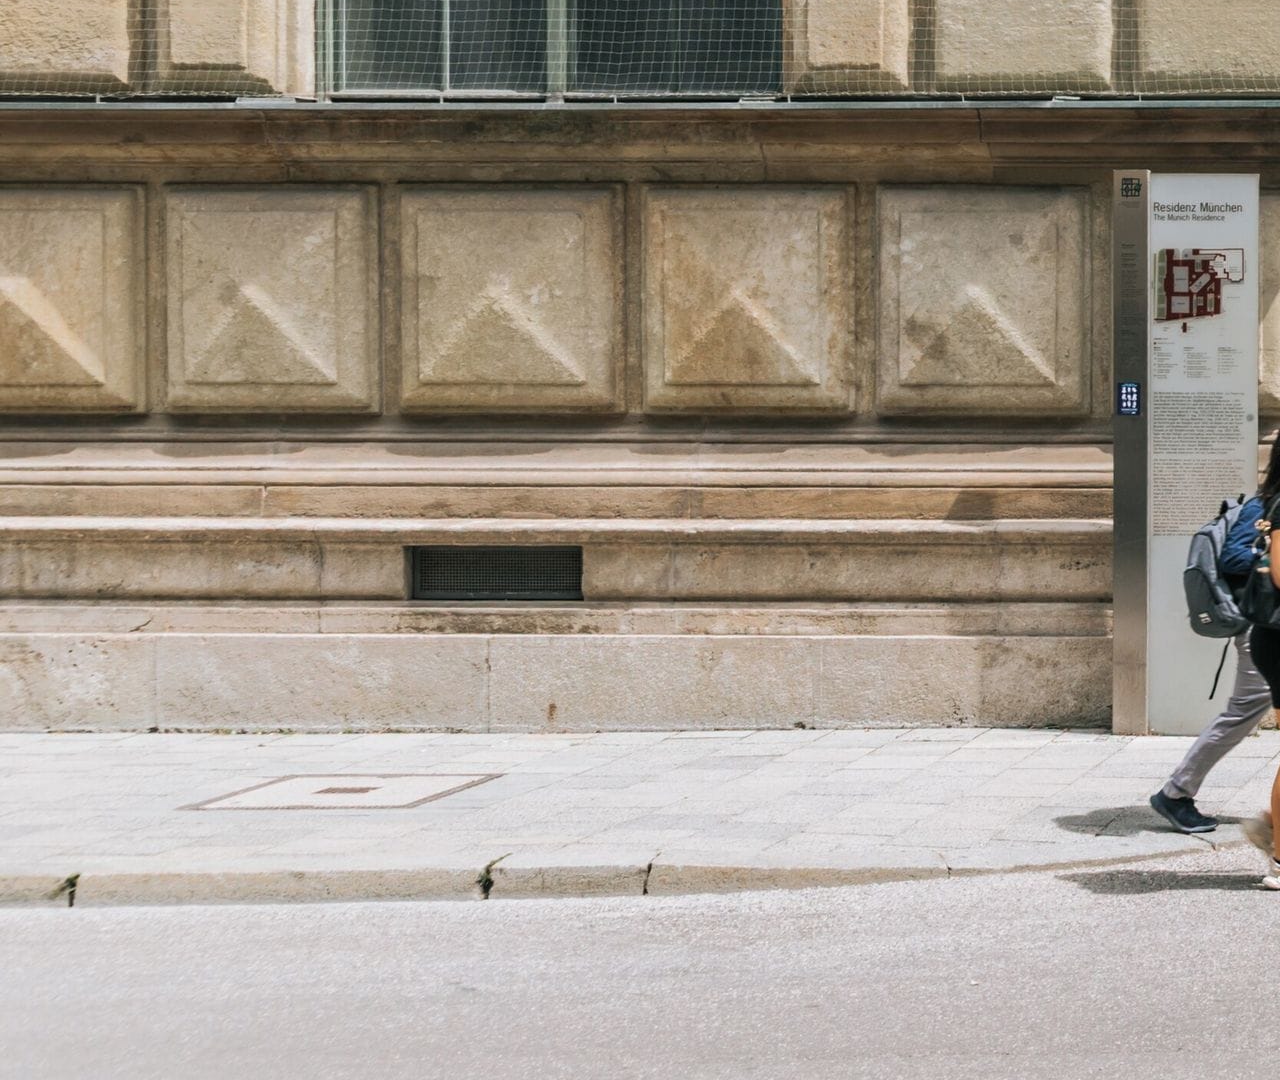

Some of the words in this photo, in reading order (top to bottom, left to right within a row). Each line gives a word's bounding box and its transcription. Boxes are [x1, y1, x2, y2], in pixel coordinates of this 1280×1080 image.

[1153, 202, 1197, 213] Residenz
[1200, 201, 1243, 213] München
[1153, 214, 1165, 222] The
[1168, 214, 1190, 222] Munich
[1192, 214, 1225, 222] Residence
